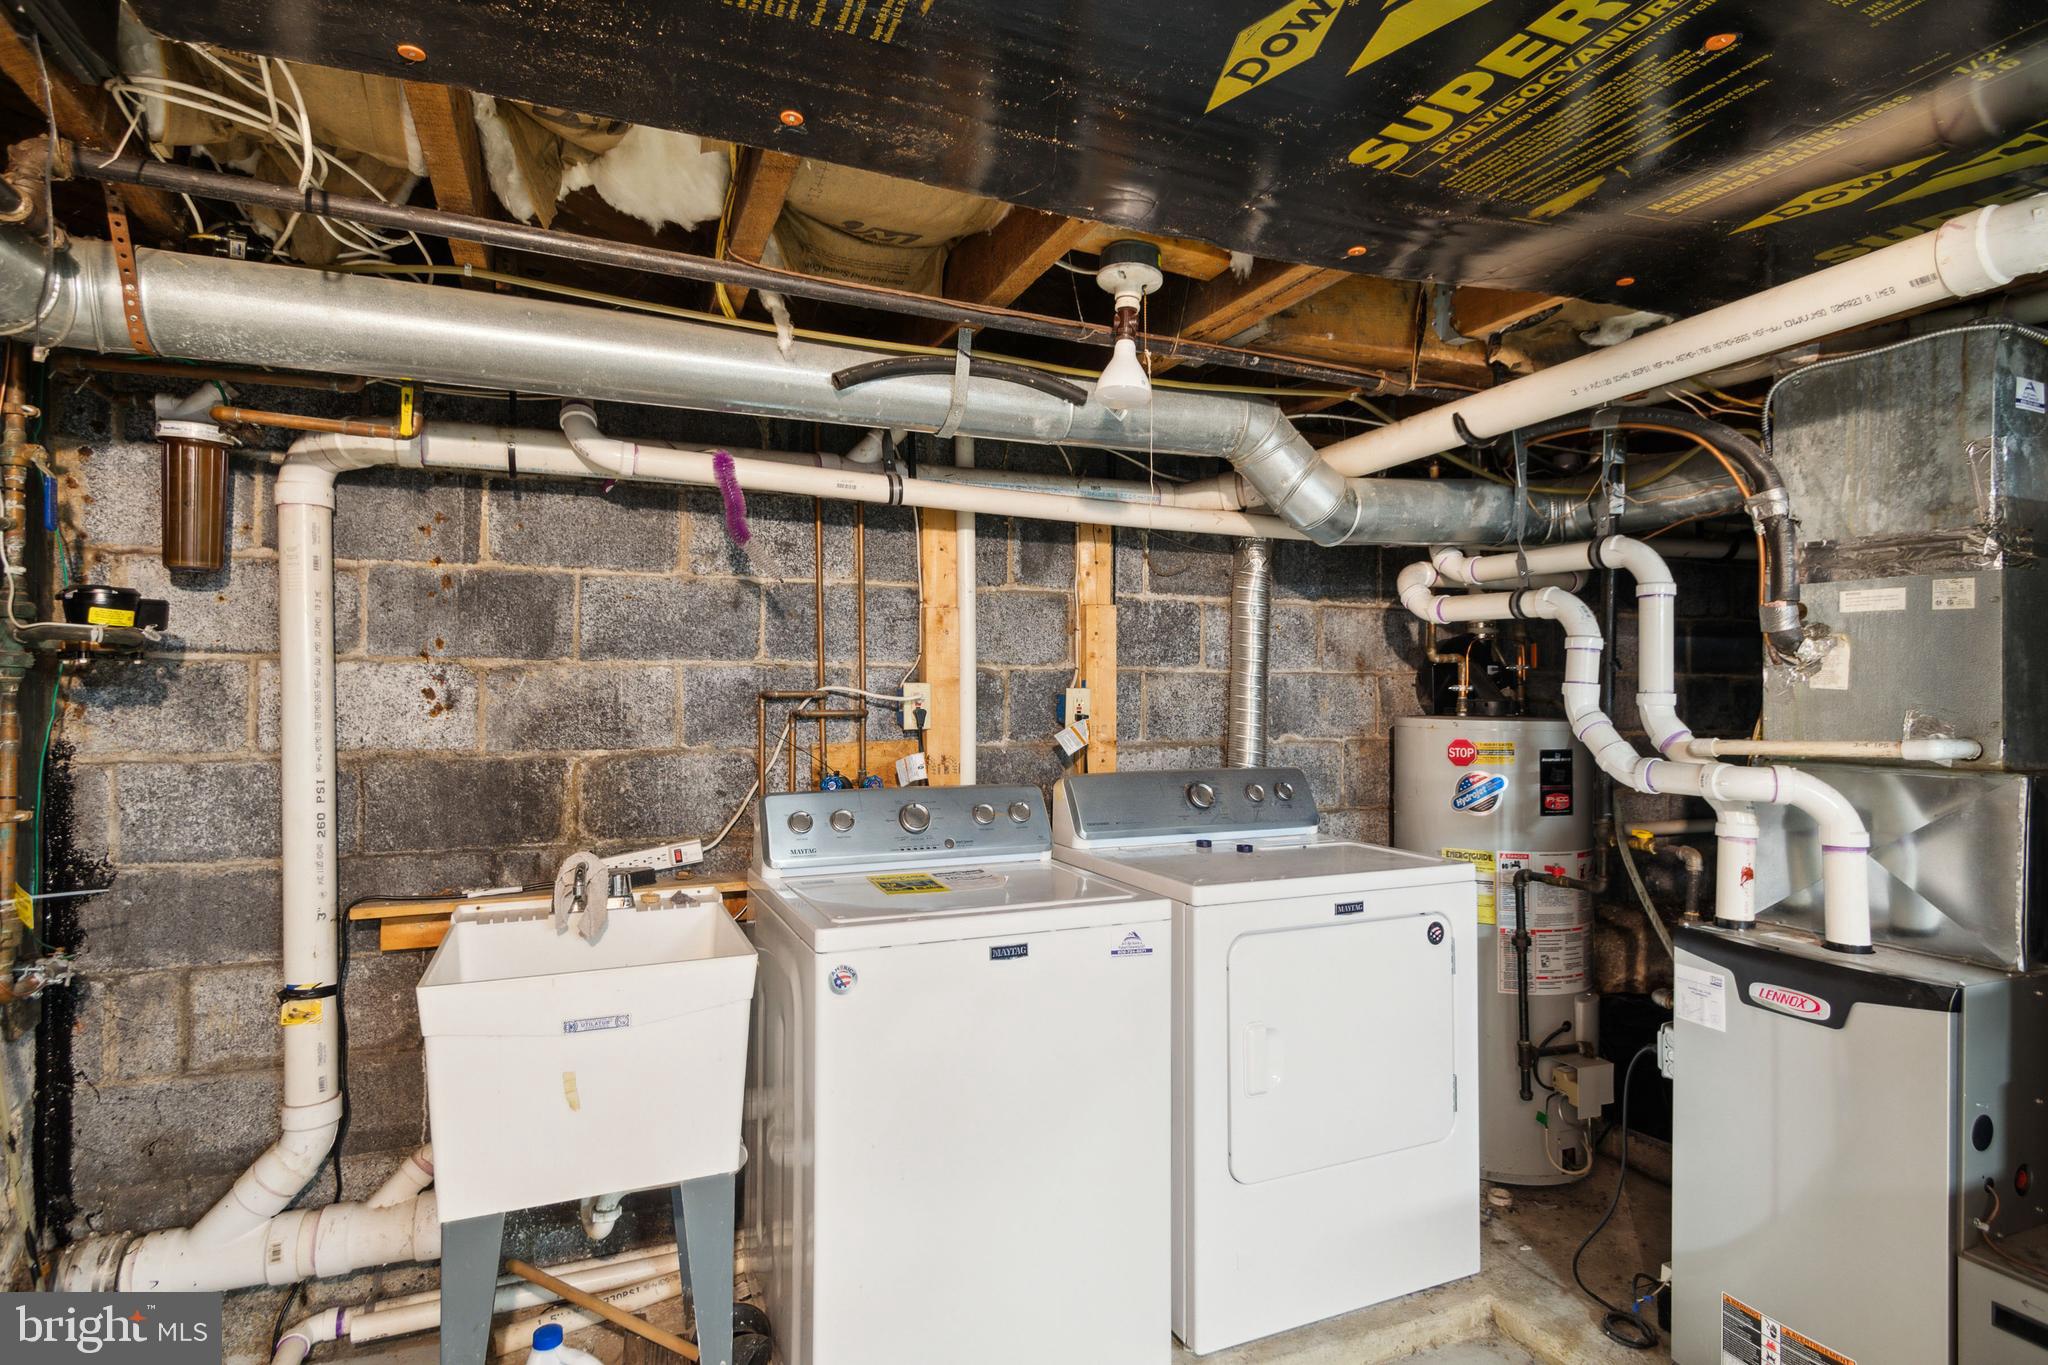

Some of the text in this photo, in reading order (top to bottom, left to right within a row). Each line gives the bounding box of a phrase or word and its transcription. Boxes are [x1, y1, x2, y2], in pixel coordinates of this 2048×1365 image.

[869, 24, 884, 41] Super
[1223, 0, 1337, 85] DOW
[1588, 35, 1658, 74] insulation
[1657, 11, 1693, 36] with
[1349, 0, 1633, 170] SUPER
[1429, 0, 1690, 154] POLYISOCYANUR
[1787, 95, 1912, 153] Thickness
[1770, 169, 1895, 218] DOW
[1449, 747, 1474, 758] STOP
[316, 779, 326, 804] PSI
[1456, 785, 1488, 807] Hydrojet
[317, 811, 327, 838] 260
[790, 847, 817, 855] MAYTAG
[1336, 902, 1364, 914] MAYTAG
[991, 945, 1028, 958] MAYTAG
[1759, 987, 1808, 1010] LENNOX
